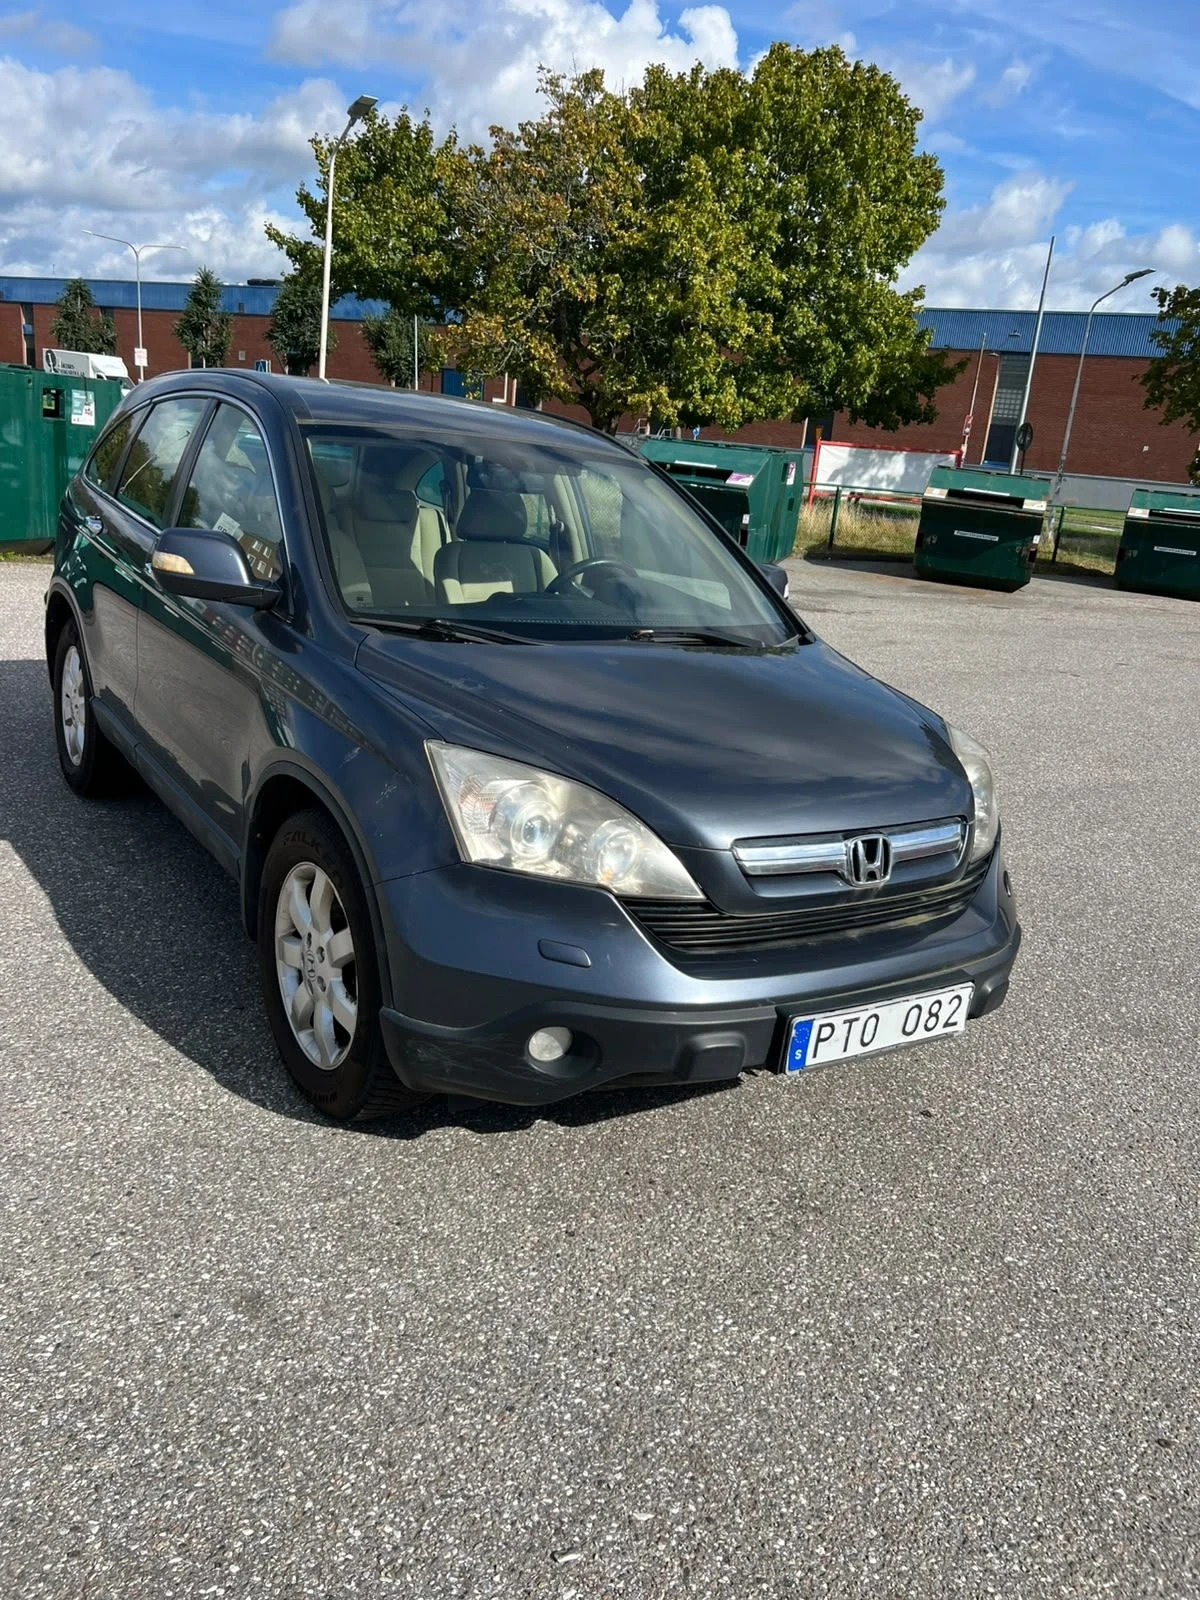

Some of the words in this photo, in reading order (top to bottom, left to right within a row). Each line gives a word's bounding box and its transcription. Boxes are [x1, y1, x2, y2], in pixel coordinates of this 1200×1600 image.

[812, 1013, 880, 1059] PTO
[901, 994, 963, 1037] 082
[794, 1049, 802, 1060] S
